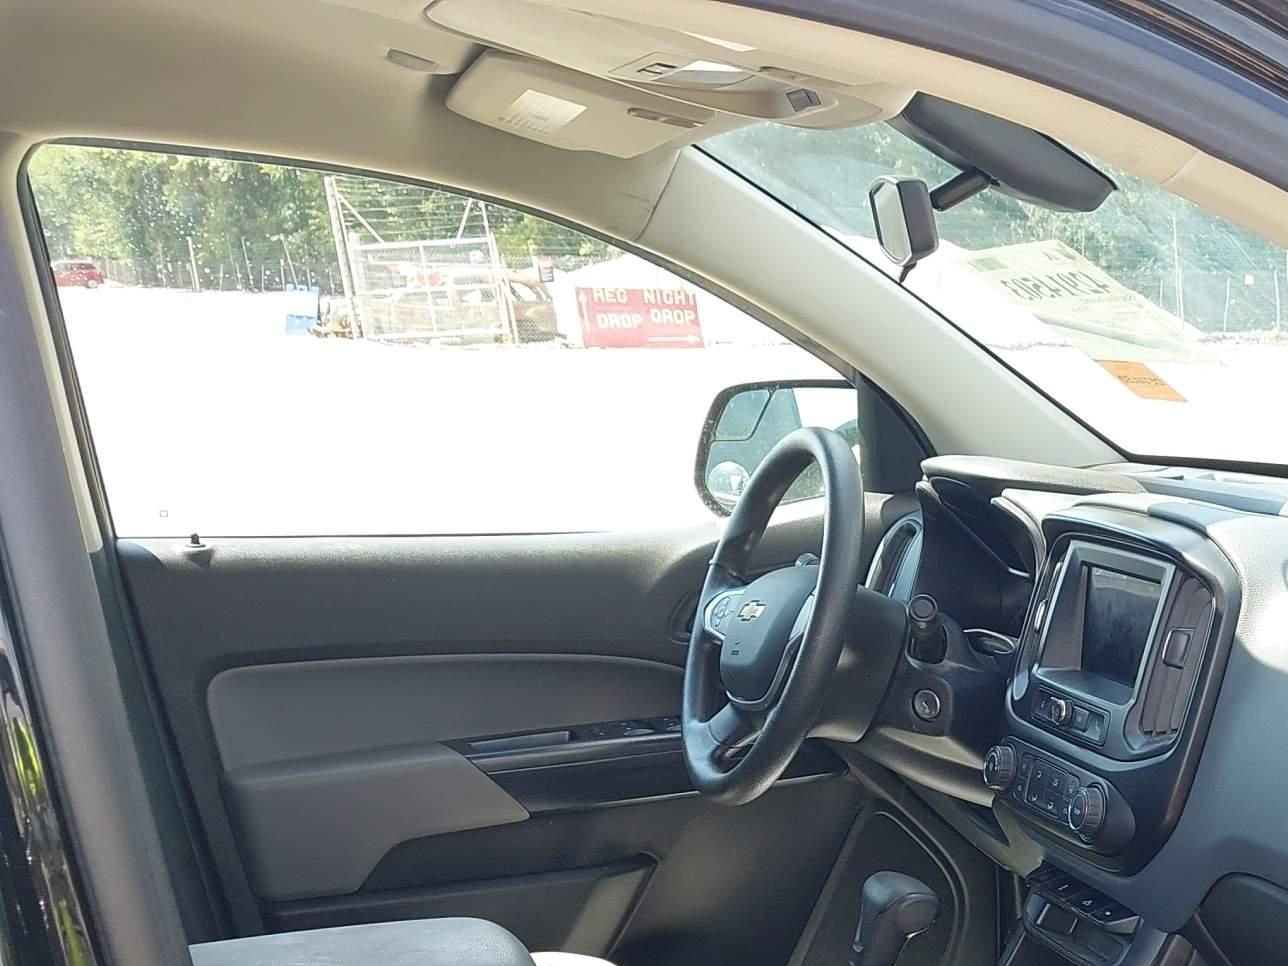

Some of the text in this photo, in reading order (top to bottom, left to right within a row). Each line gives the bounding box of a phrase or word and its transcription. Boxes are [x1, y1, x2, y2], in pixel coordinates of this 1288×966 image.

[641, 287, 697, 305] NIGHT
[596, 307, 696, 329] DROP DROP
